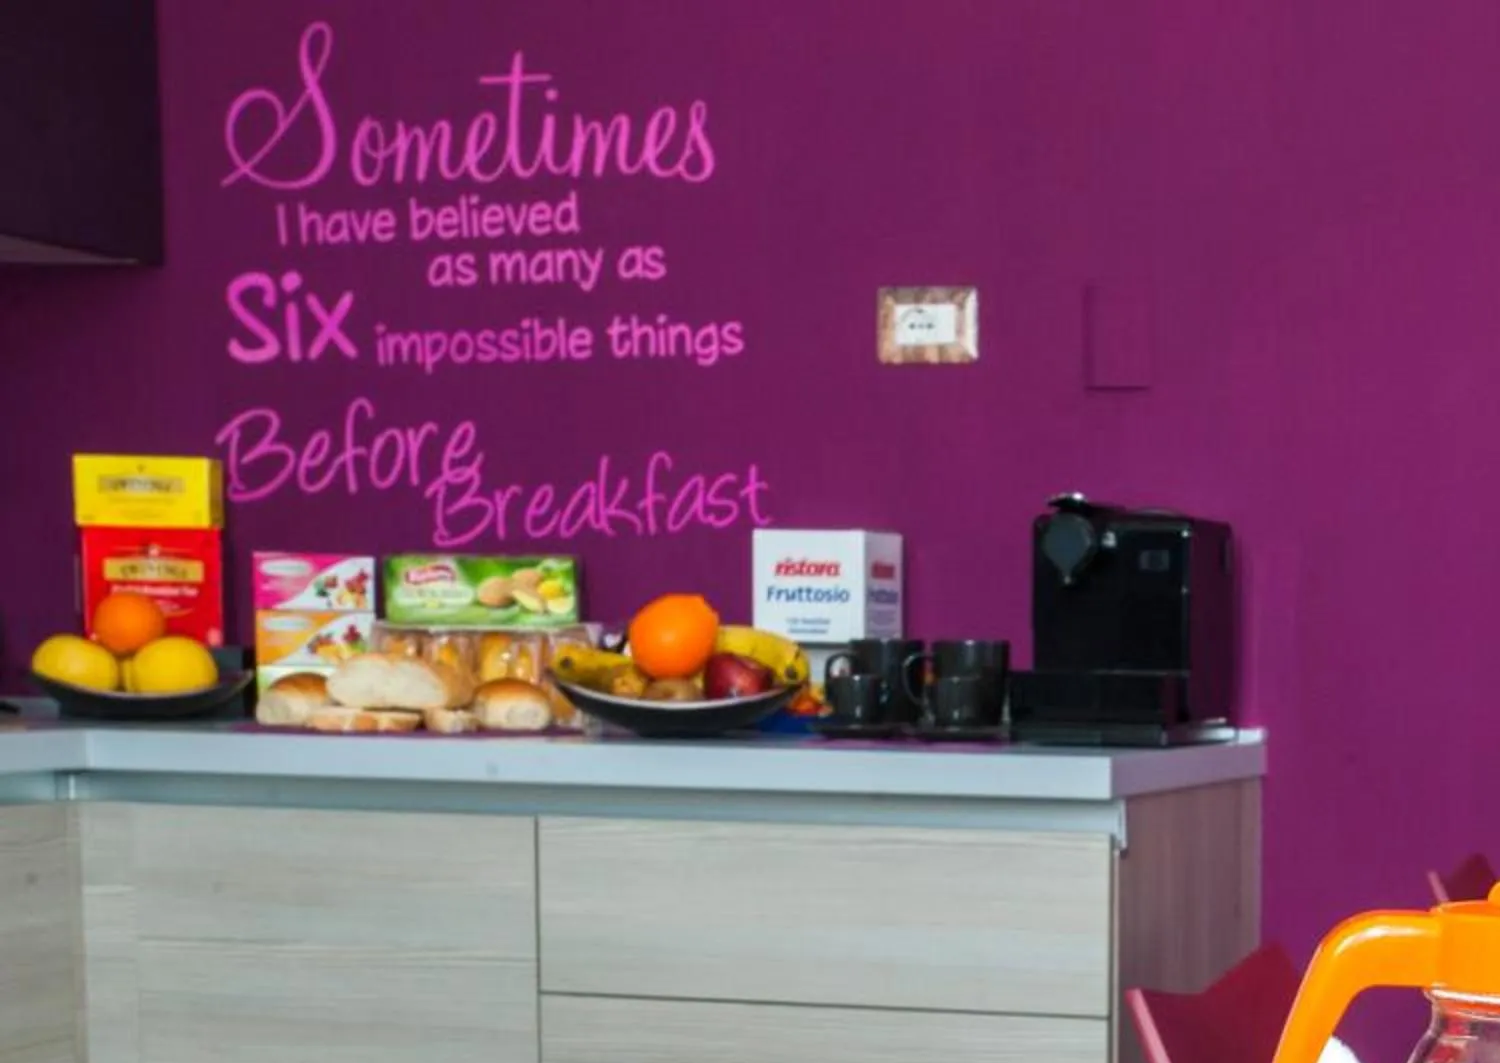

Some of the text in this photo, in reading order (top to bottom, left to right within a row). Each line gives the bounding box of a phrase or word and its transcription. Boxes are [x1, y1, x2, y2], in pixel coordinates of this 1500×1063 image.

[221, 20, 716, 190] Sometimes
[275, 191, 580, 247] I have believed
[427, 245, 667, 292] as many as
[225, 270, 745, 374] Six impossible things
[215, 397, 485, 503] Before
[425, 450, 773, 548] Breakfast
[766, 585, 851, 603] Fruttosio
[774, 558, 842, 577] ristora
